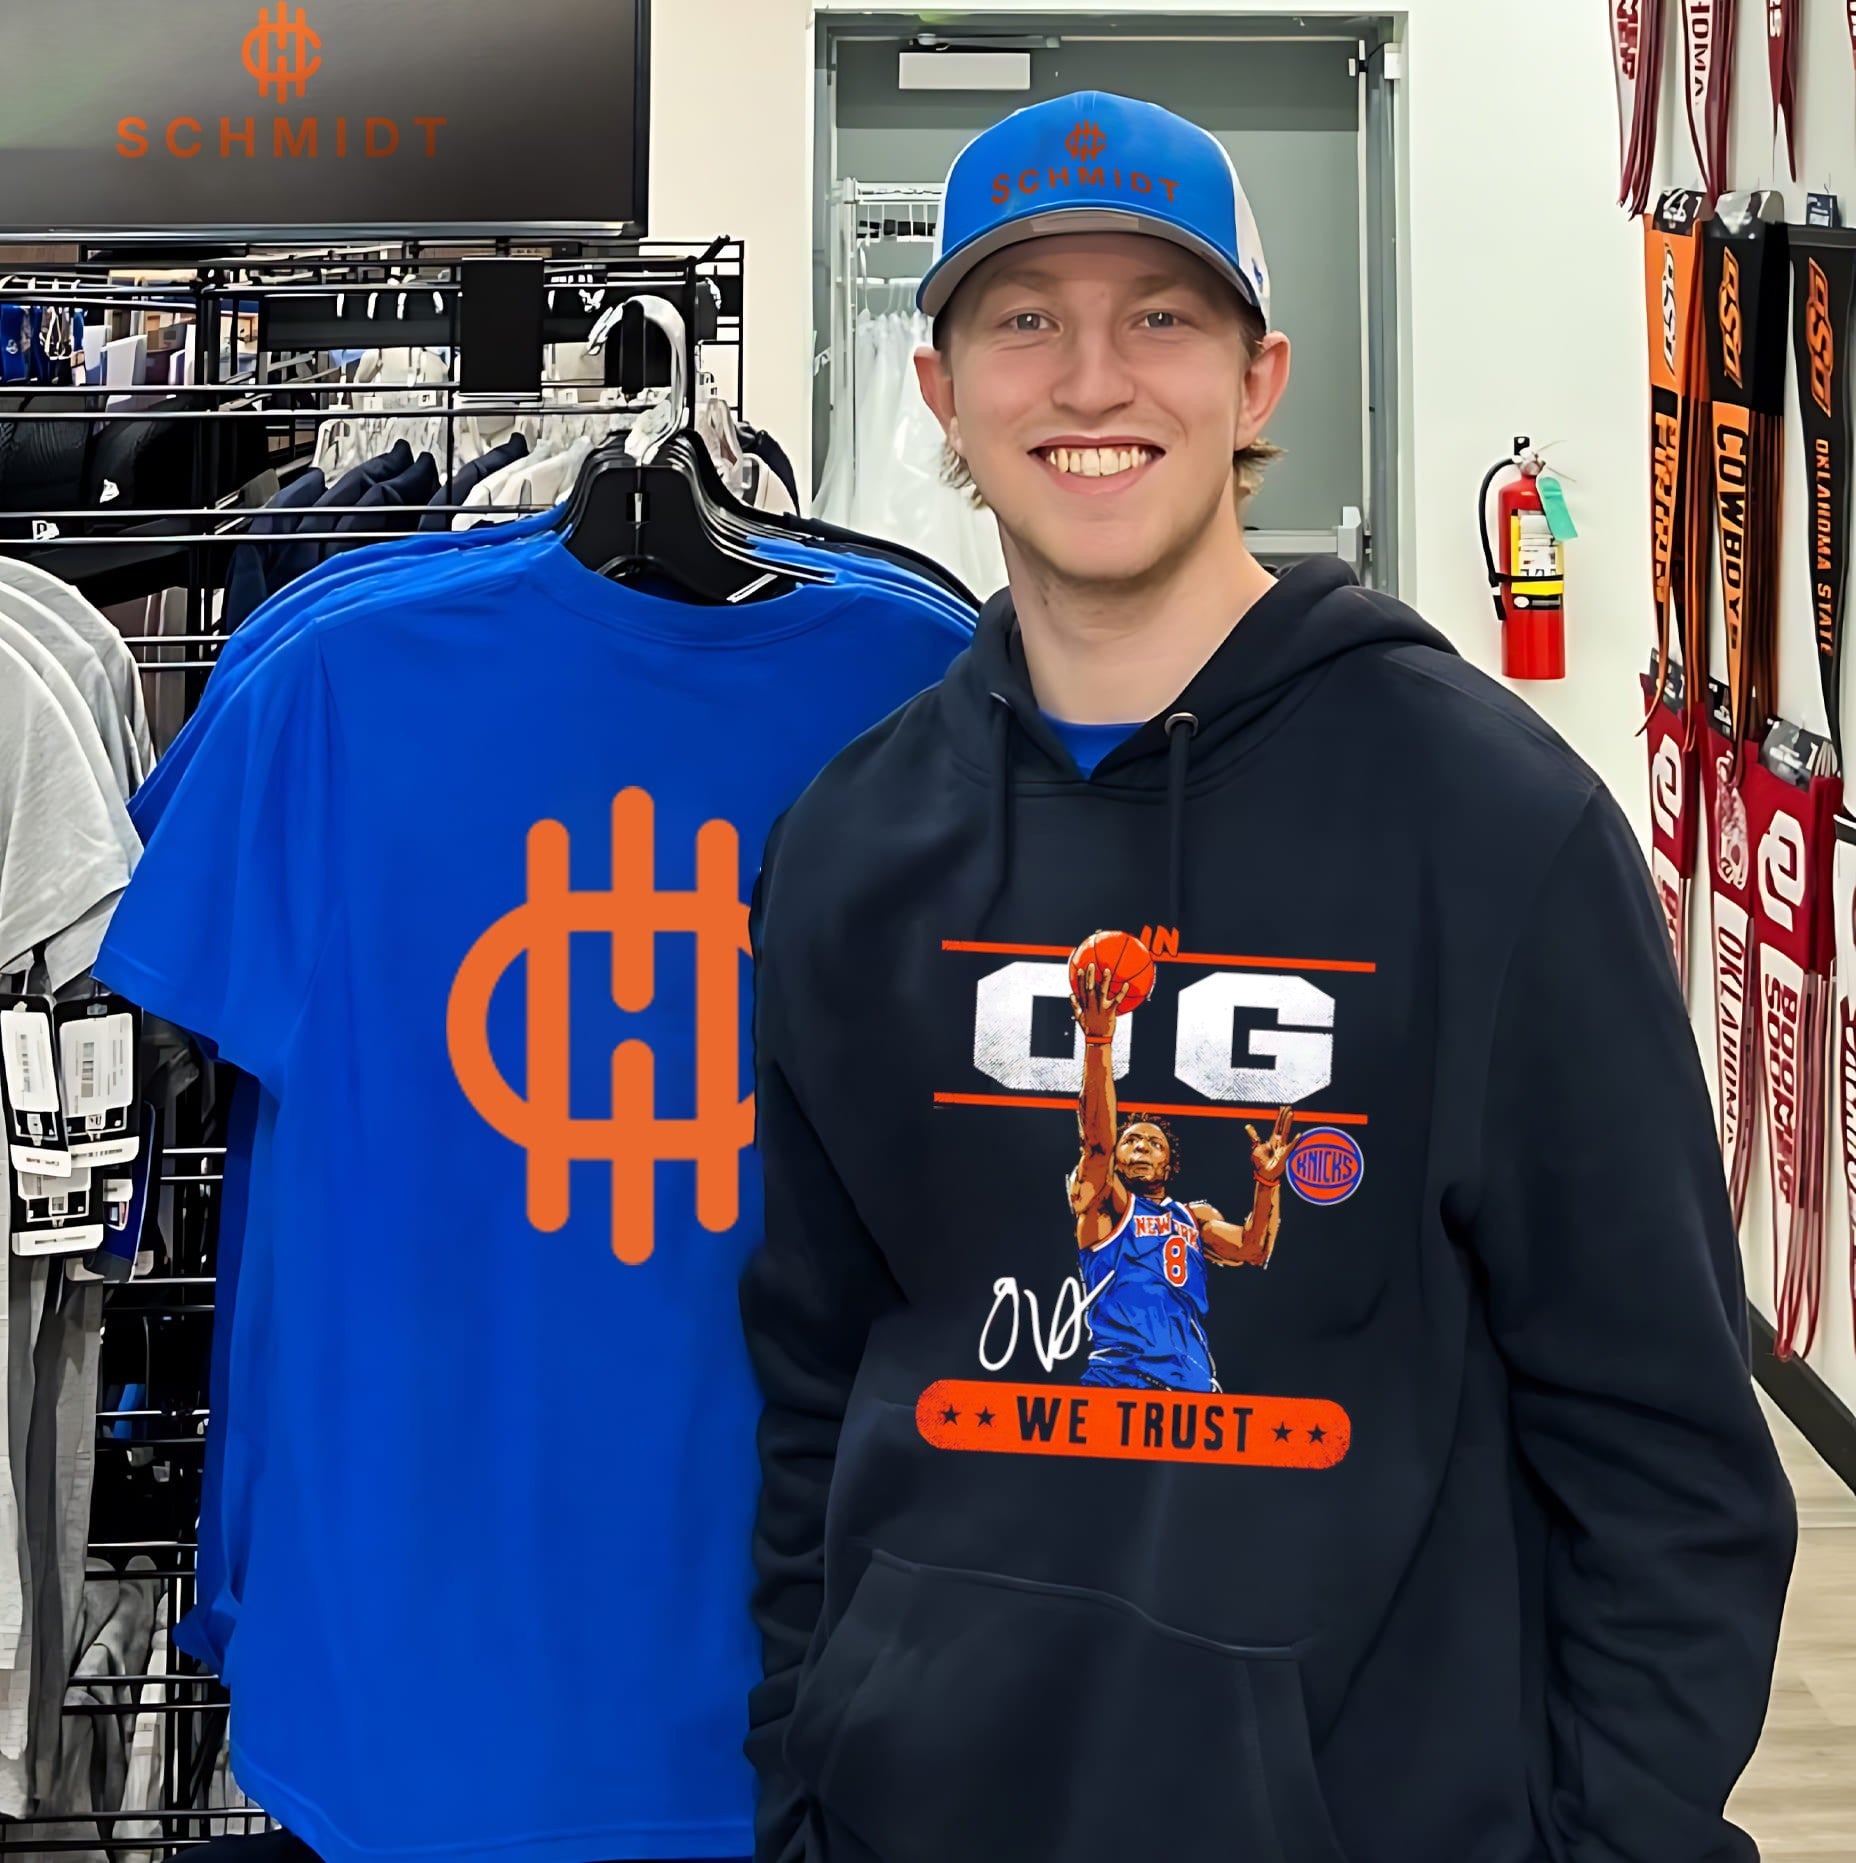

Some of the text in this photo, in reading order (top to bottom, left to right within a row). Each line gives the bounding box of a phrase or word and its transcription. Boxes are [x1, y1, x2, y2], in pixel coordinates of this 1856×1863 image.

[116, 116, 447, 159] SCHMIDT
[991, 166, 1179, 205] SCHMIDT
[1815, 438, 1832, 570] OKLAHOMA
[1140, 924, 1180, 957] IN
[974, 961, 1335, 1104] OG
[1297, 1150, 1353, 1182] KNICKS
[1134, 1211, 1172, 1237] NEW
[1163, 1235, 1188, 1287] 8
[1016, 1395, 1253, 1452] WE TRUST
